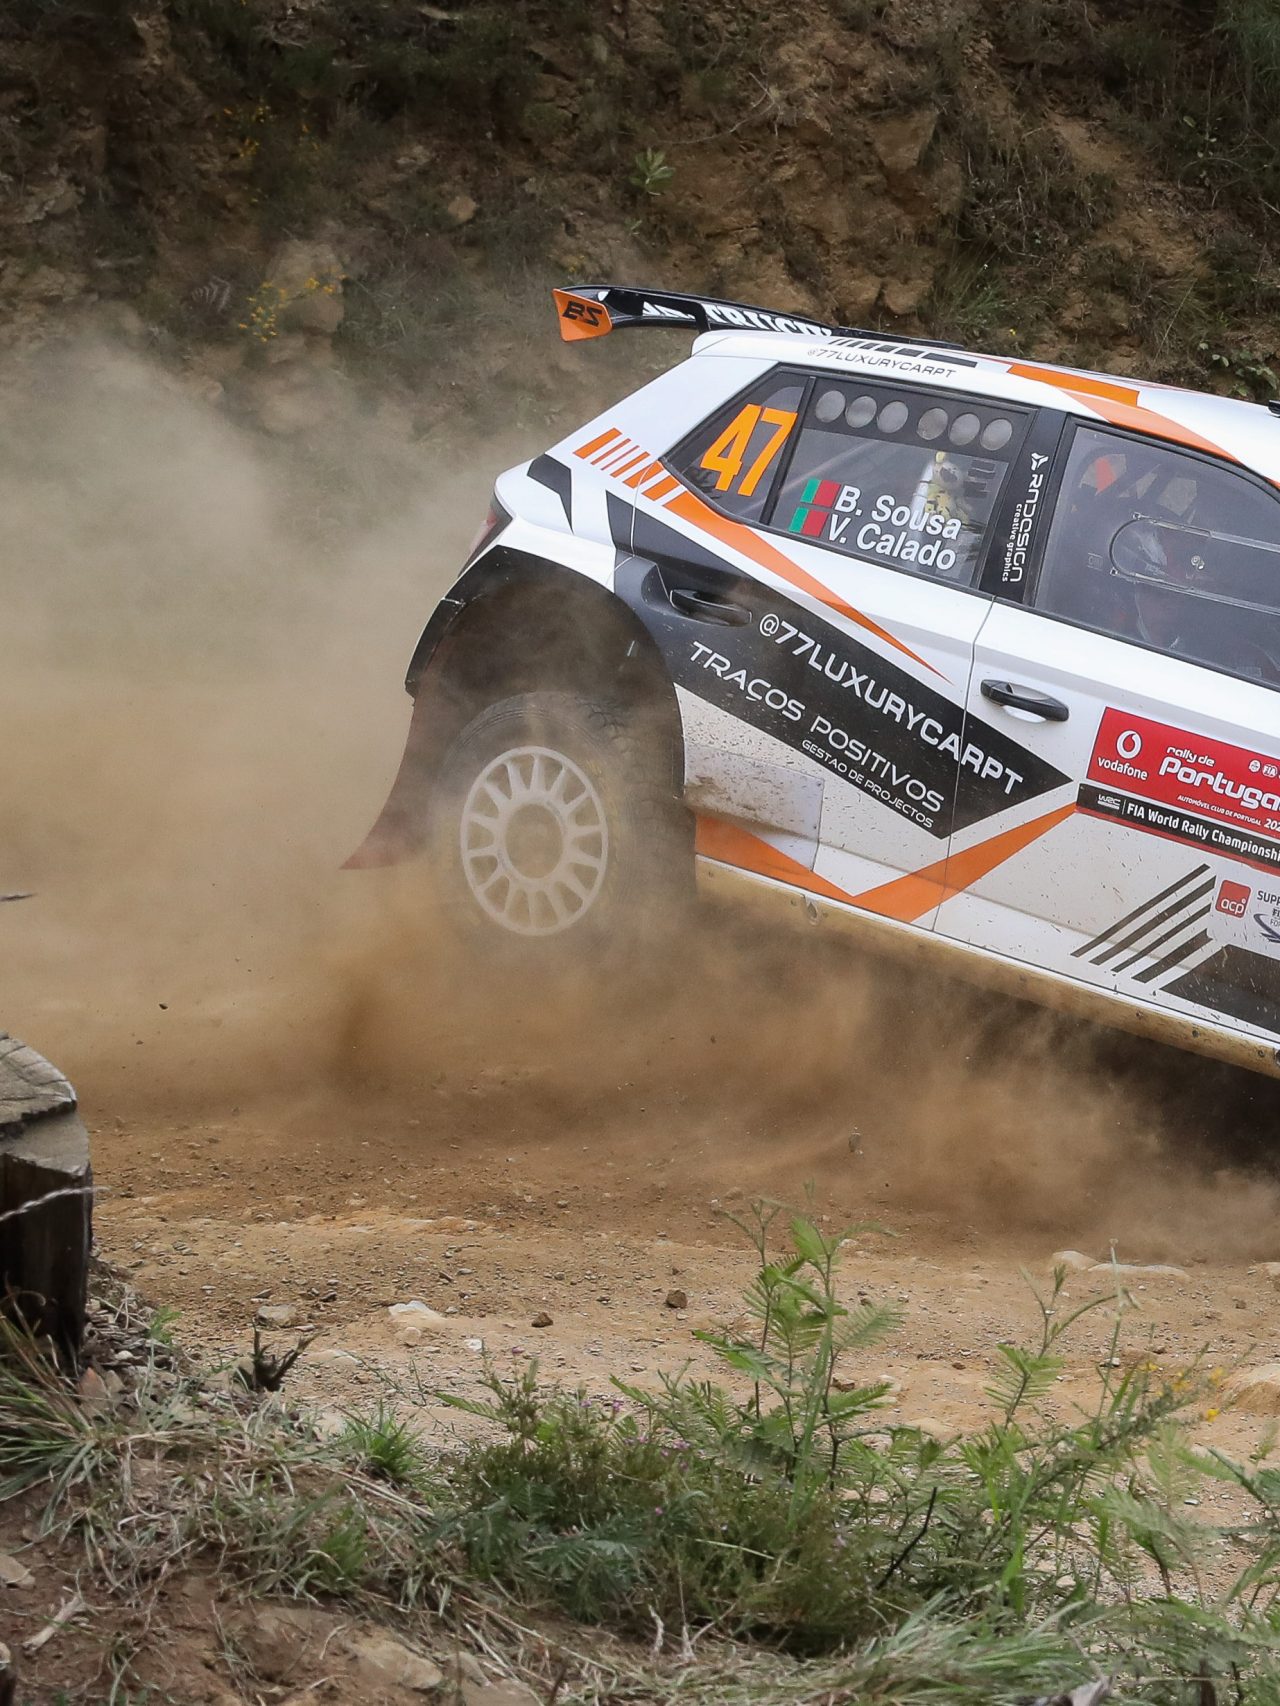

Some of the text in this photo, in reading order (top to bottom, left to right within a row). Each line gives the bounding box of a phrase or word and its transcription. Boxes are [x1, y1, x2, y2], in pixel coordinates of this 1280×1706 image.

[807, 348, 957, 378] @77LUXURYCARPT
[700, 403, 798, 496] 47
[824, 485, 962, 540] B. Sousa
[1008, 503, 1022, 540] creative
[828, 513, 956, 570] V. Calado
[1002, 542, 1015, 582] graphics
[759, 613, 1024, 795] @77LUXURYCARPT
[690, 641, 944, 813] TRAÇOS POSITIVOS
[1098, 757, 1148, 781] vodafone
[1167, 747, 1215, 767] rally de
[1263, 765, 1276, 777] FIA
[801, 739, 934, 829] GESTAO DE PROJECTOS
[1127, 803, 1145, 819] FIA
[1148, 809, 1180, 829] World
[1181, 820, 1209, 840] Rally
[1210, 805, 1226, 815] CLUB
[1233, 812, 1262, 826] PORTUGAL
[1221, 898, 1245, 915] acp
